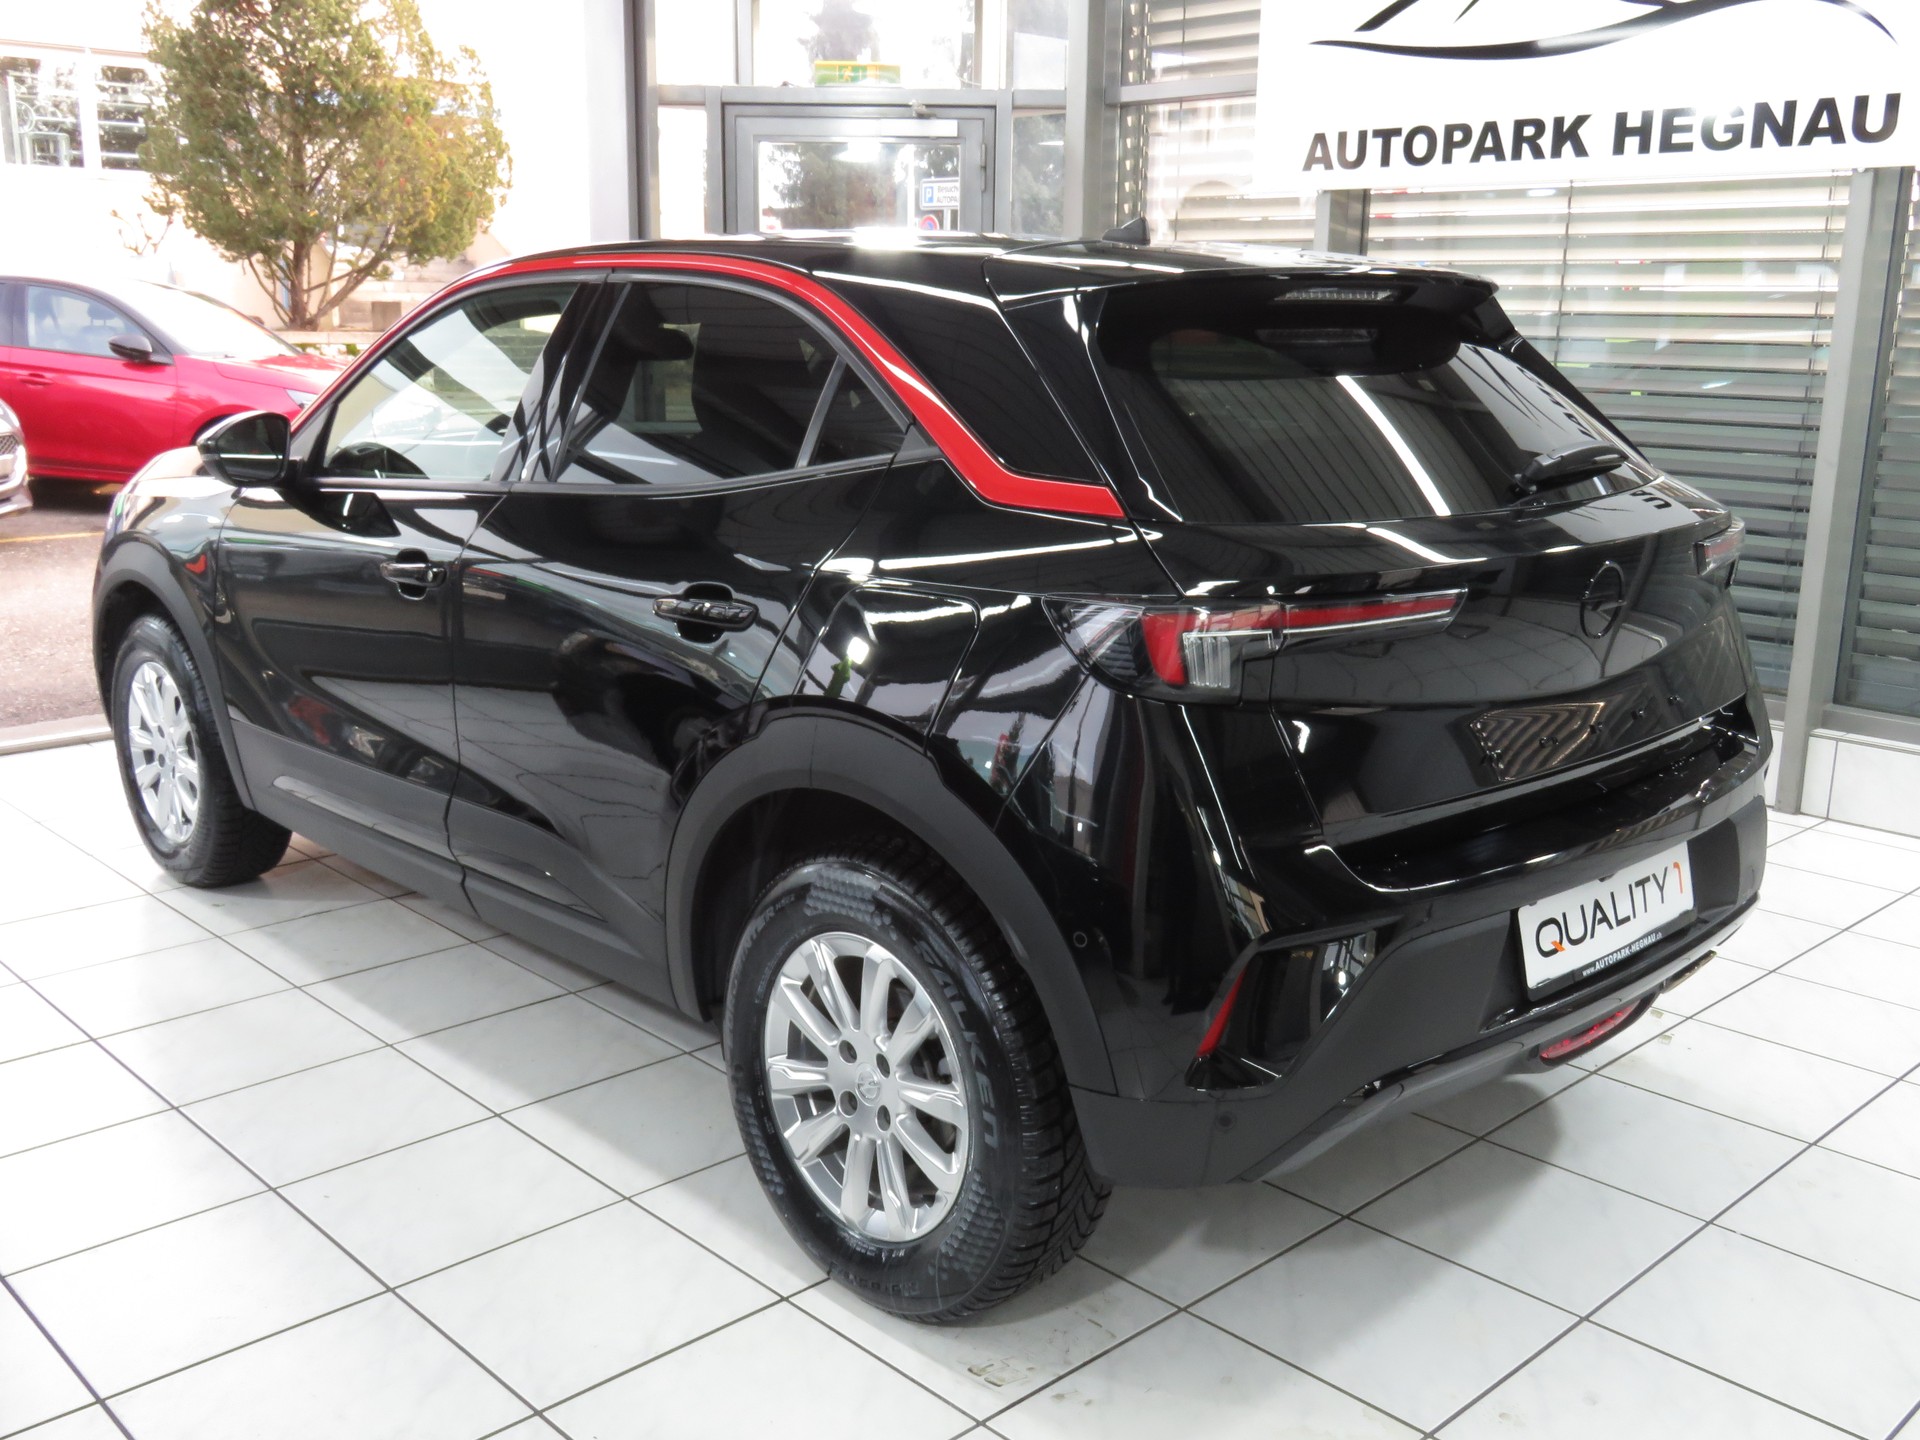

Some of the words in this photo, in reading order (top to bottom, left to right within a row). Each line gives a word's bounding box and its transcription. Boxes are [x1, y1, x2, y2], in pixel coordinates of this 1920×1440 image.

[1302, 114, 1593, 172] AUTOPARK
[1612, 93, 1902, 156] HEGNAU
[1582, 931, 1663, 977] www.AUTOPARK-HEGNAU.ch
